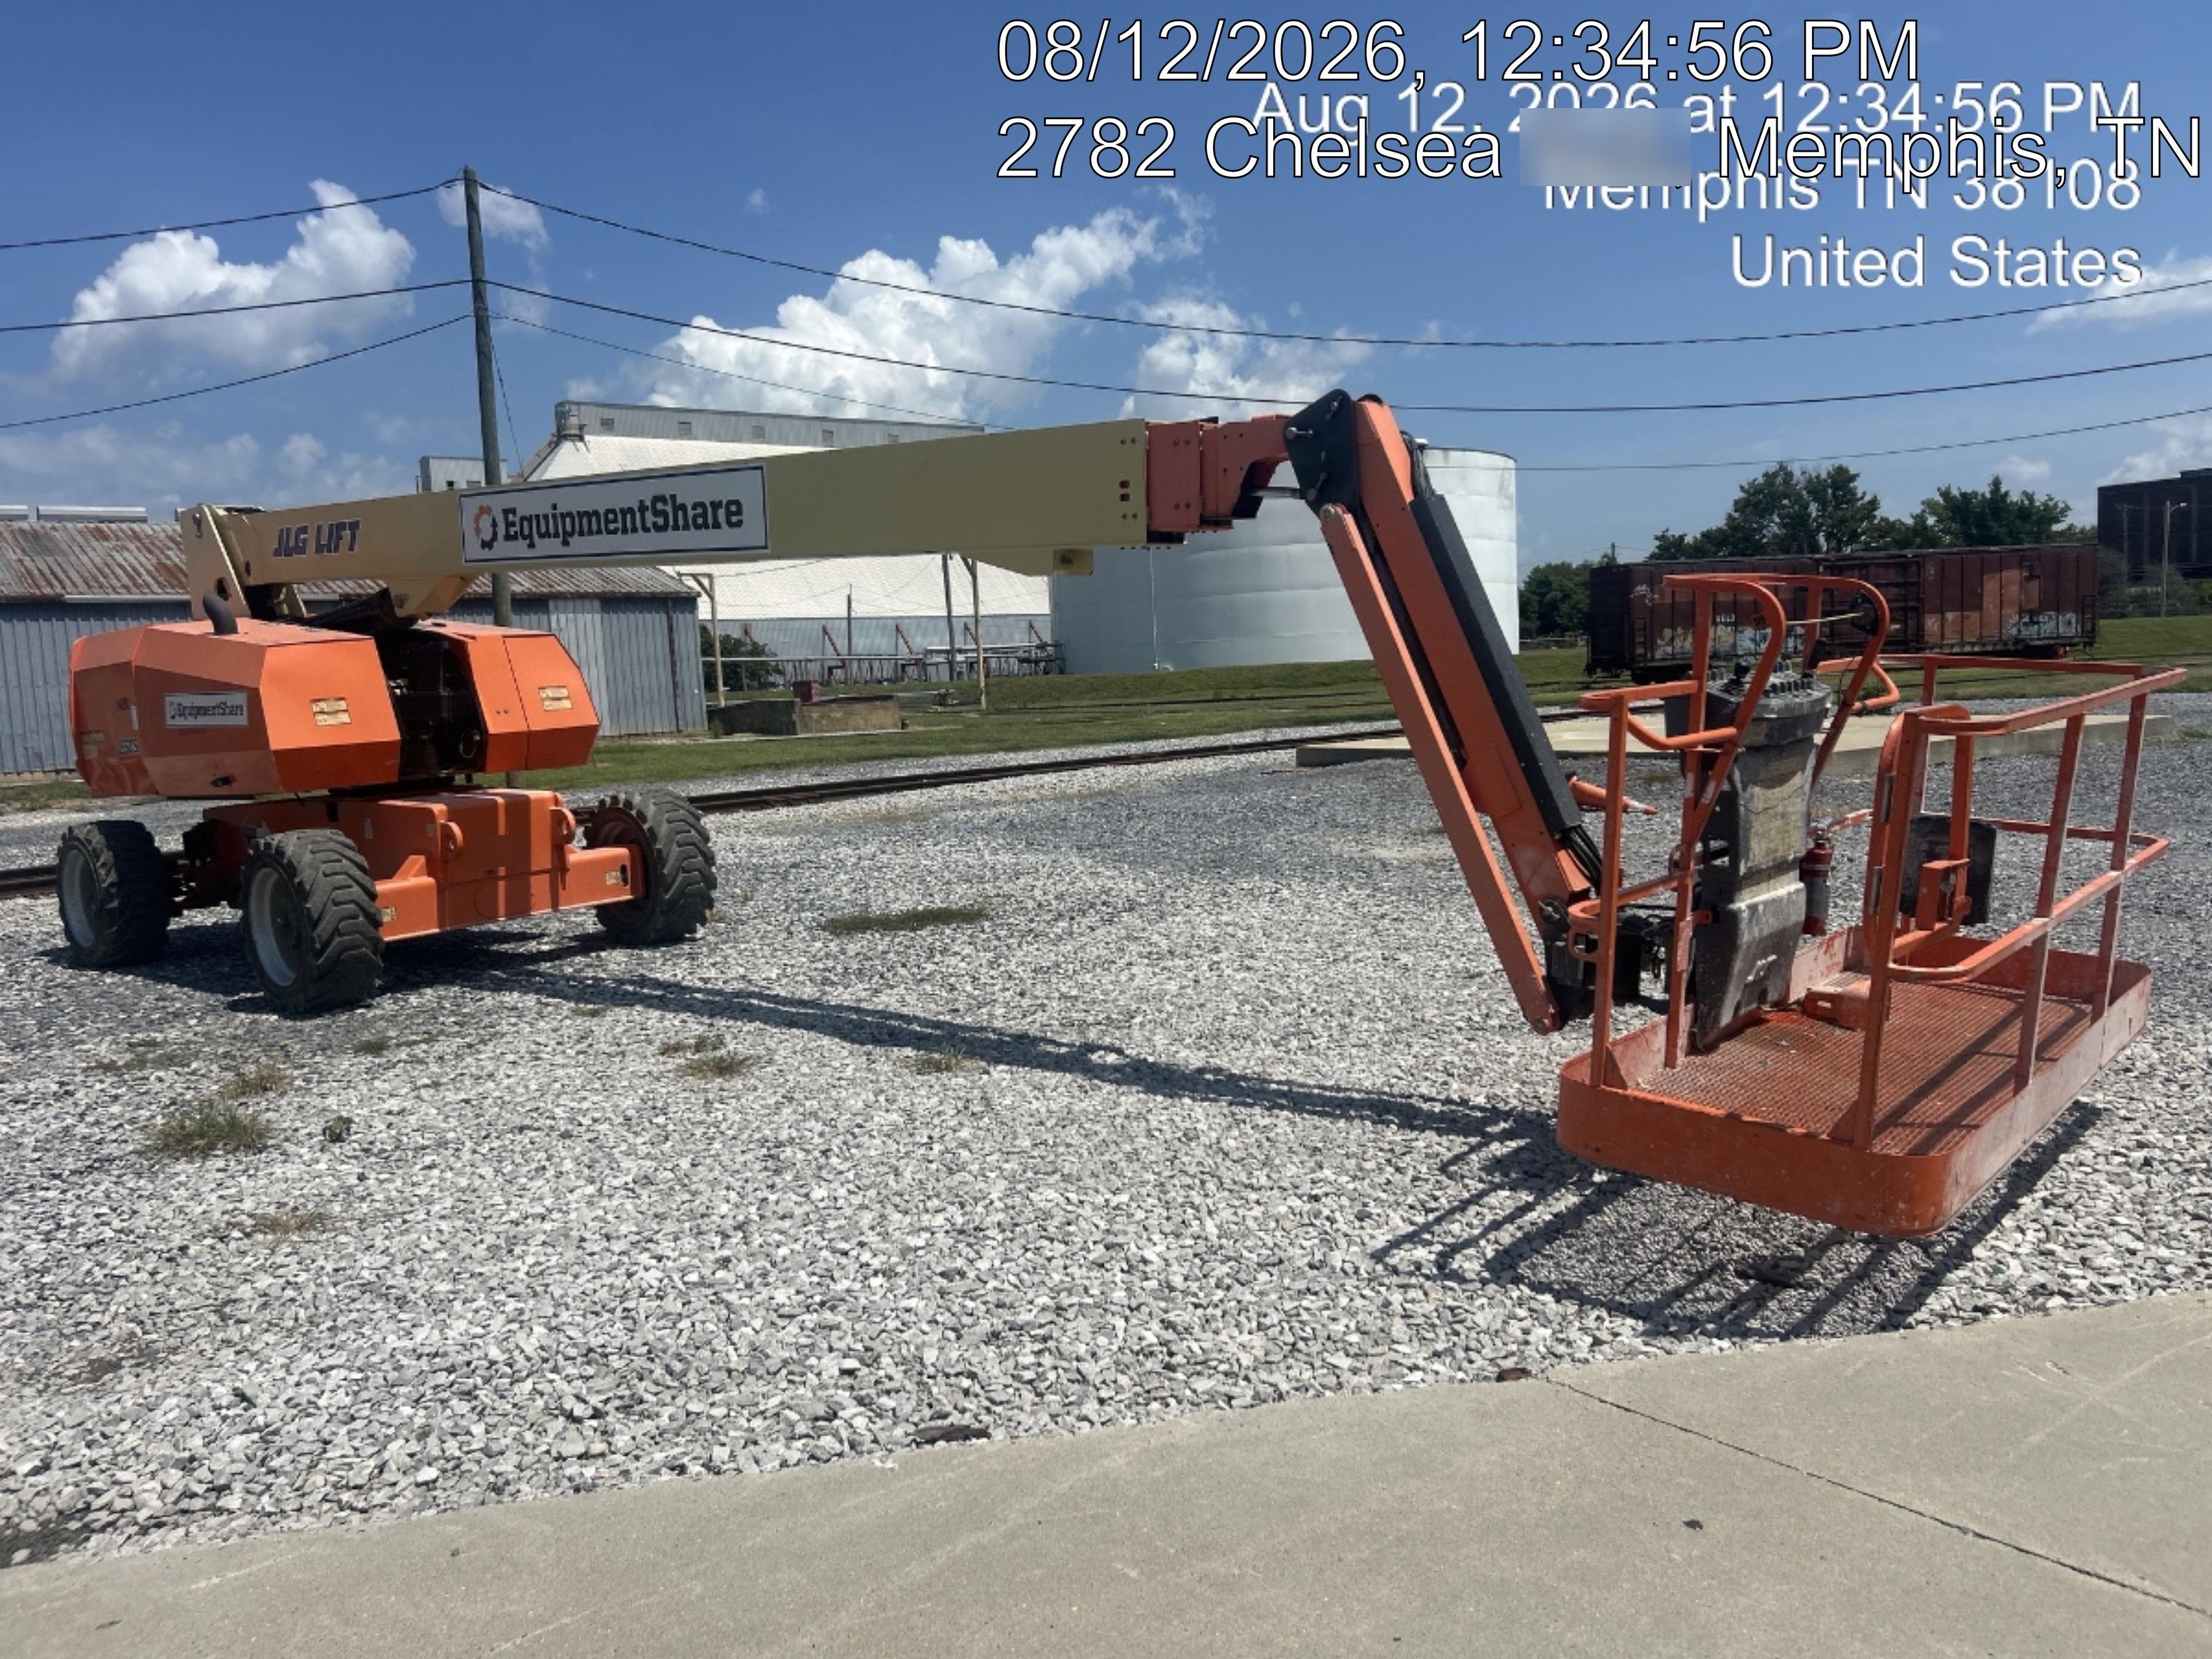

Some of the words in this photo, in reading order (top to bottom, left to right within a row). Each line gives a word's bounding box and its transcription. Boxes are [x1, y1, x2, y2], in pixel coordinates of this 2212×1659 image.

[272, 524, 309, 558] JLG
[314, 517, 361, 555] LIFT
[501, 493, 744, 549] EquipmentShare
